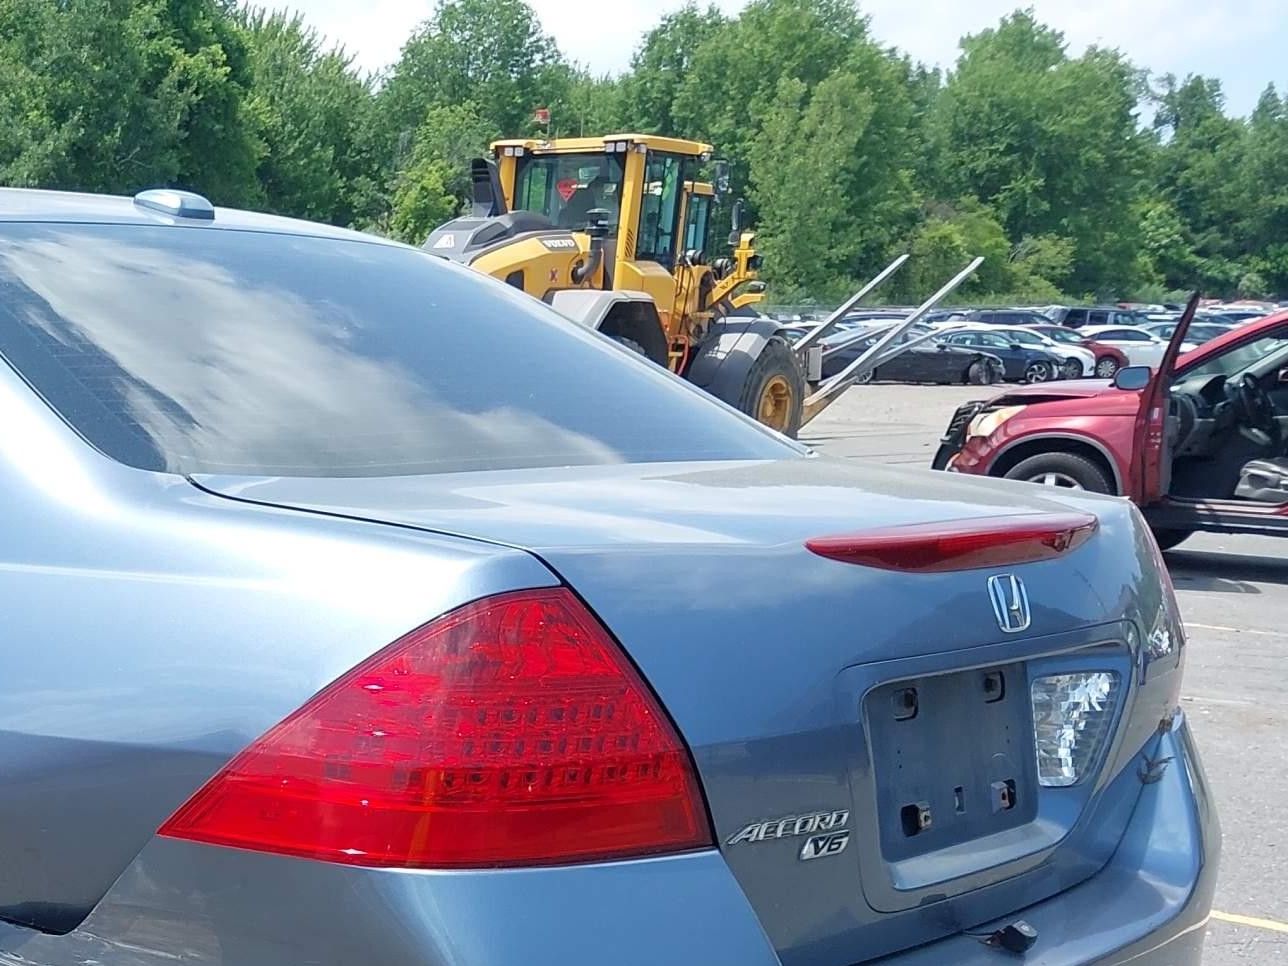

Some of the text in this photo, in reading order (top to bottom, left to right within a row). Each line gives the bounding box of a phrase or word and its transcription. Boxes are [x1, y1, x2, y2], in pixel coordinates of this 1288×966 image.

[542, 239, 575, 248] VOLVO
[727, 810, 849, 845] ACCORD
[809, 833, 846, 857] V6
